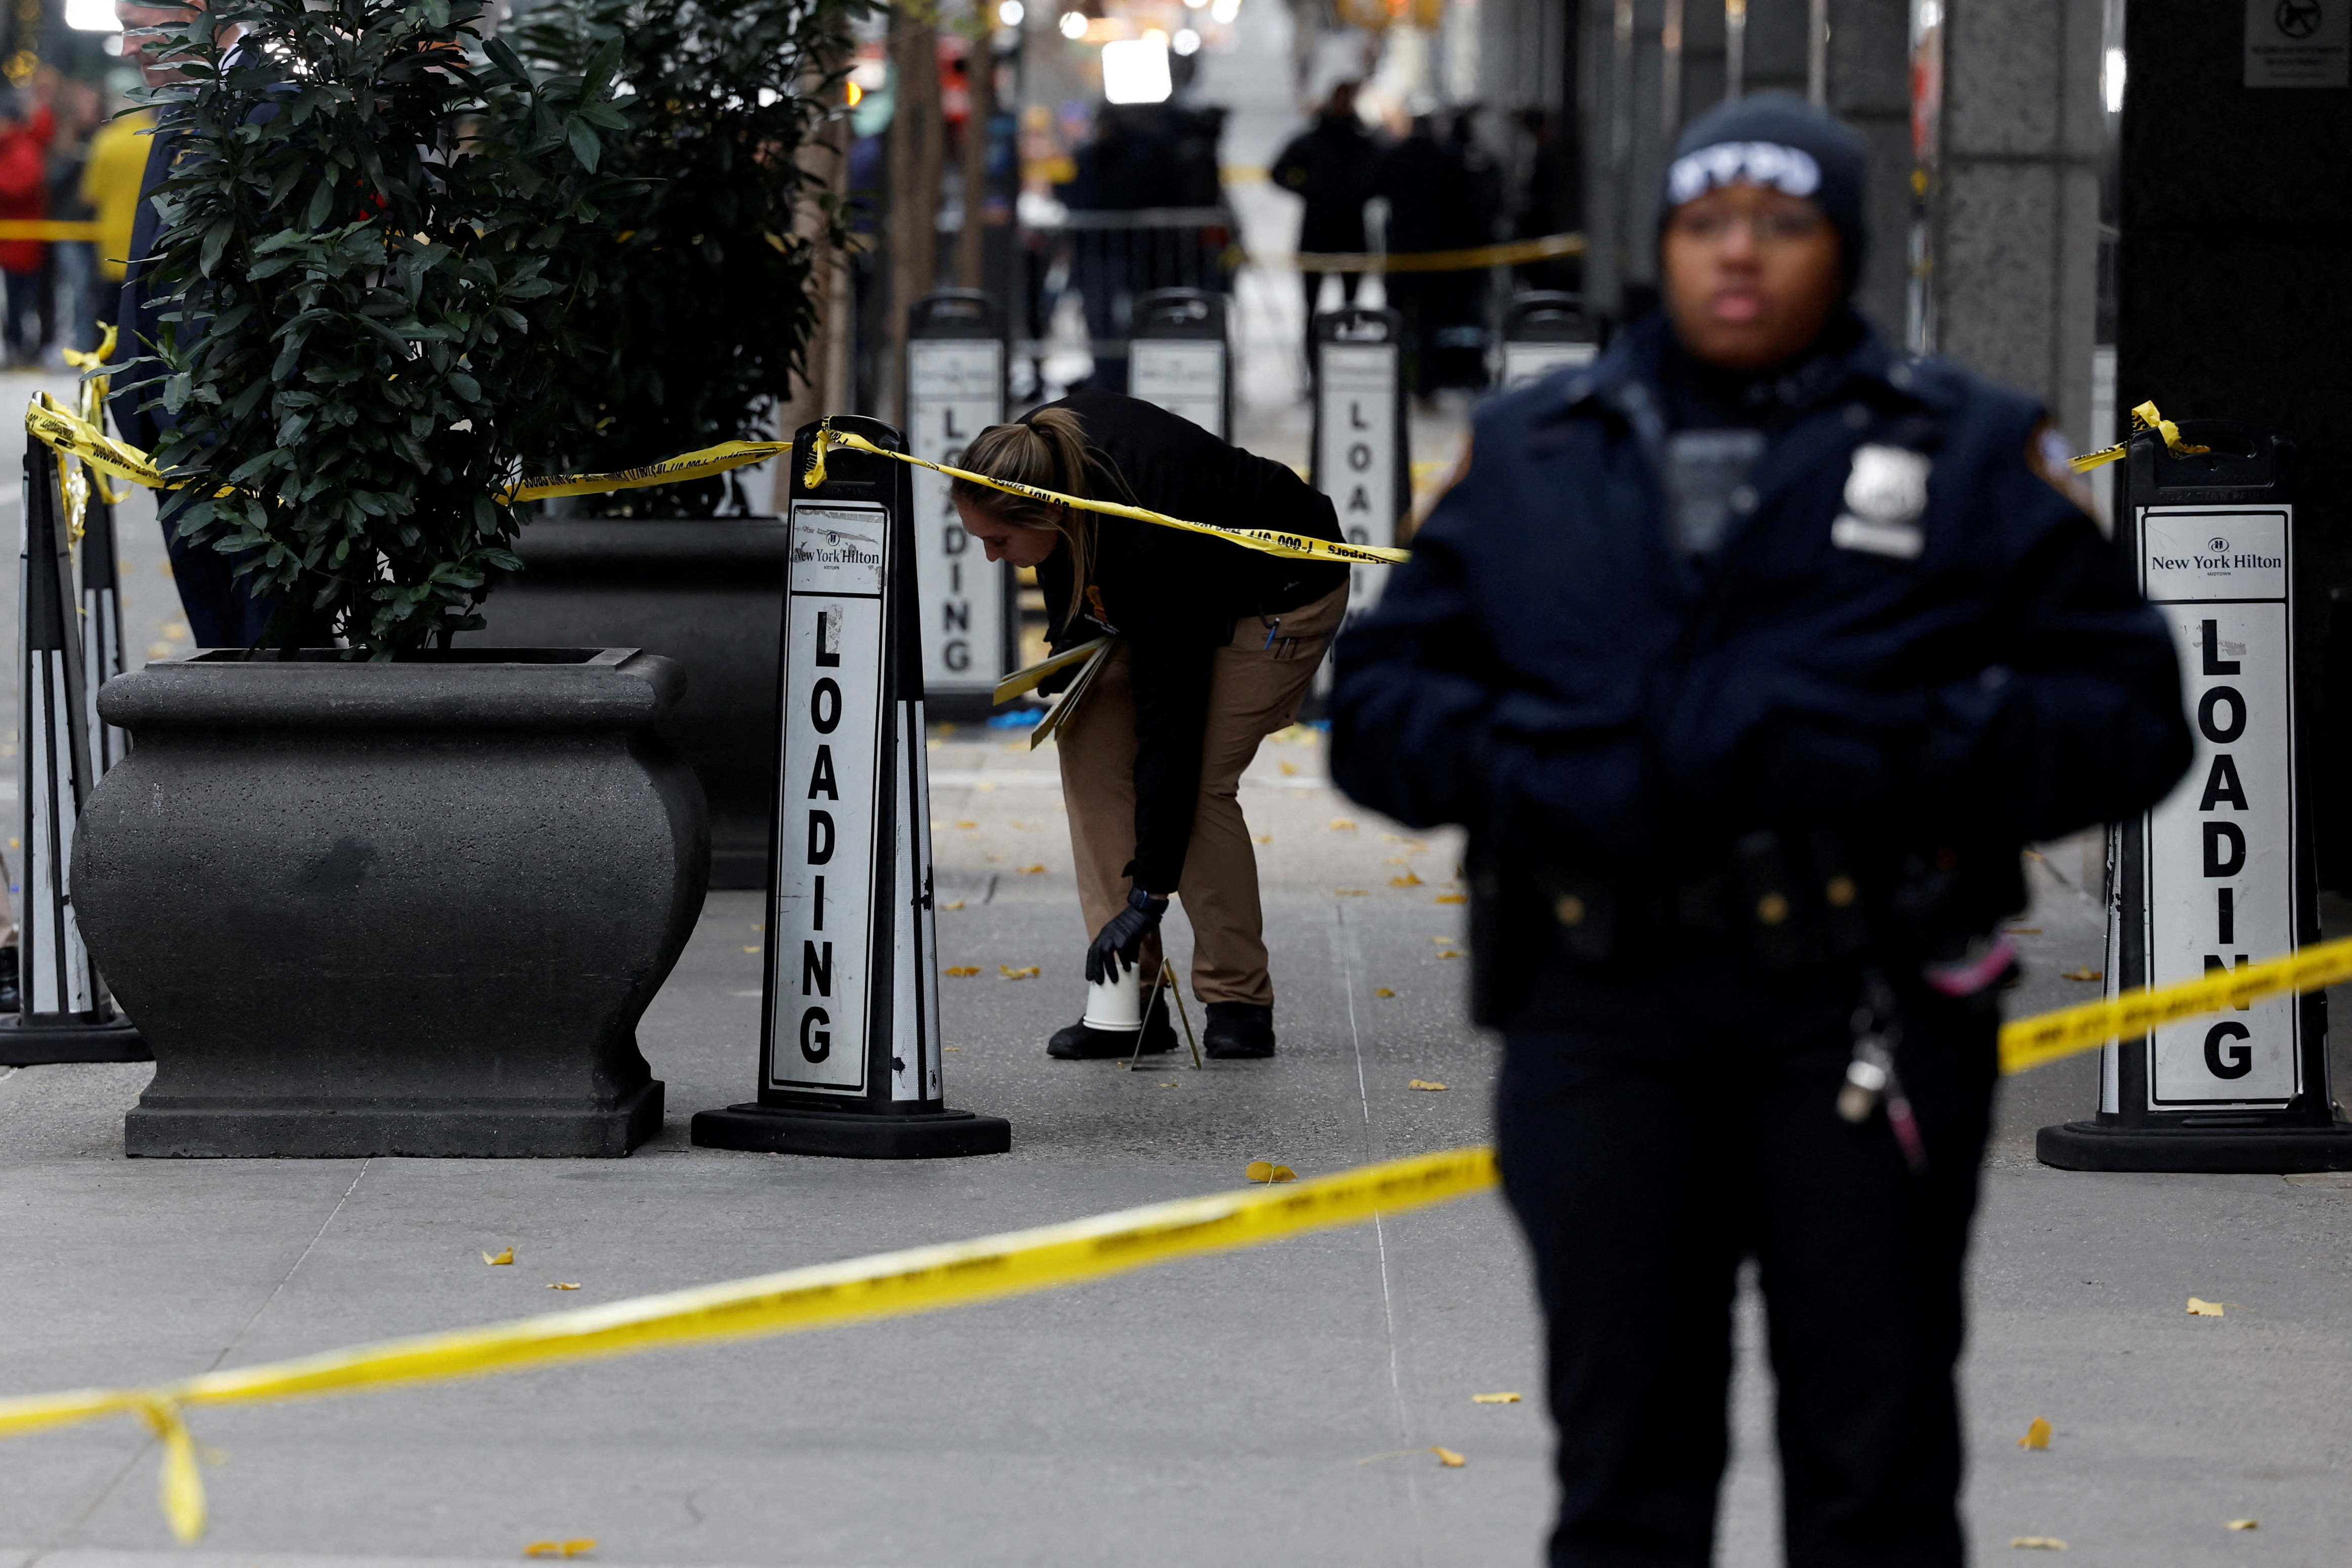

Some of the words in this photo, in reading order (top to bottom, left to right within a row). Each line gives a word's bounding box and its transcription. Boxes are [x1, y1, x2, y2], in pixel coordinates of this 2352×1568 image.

[795, 548, 815, 562] New
[817, 548, 840, 563] York
[842, 549, 880, 564] Hilton
[943, 408, 970, 672] LDING
[1347, 401, 1371, 626] LOADI
[2152, 557, 2190, 570] New
[2193, 555, 2231, 569] York
[2234, 554, 2282, 568] Hilton
[799, 611, 843, 1064] LOADING
